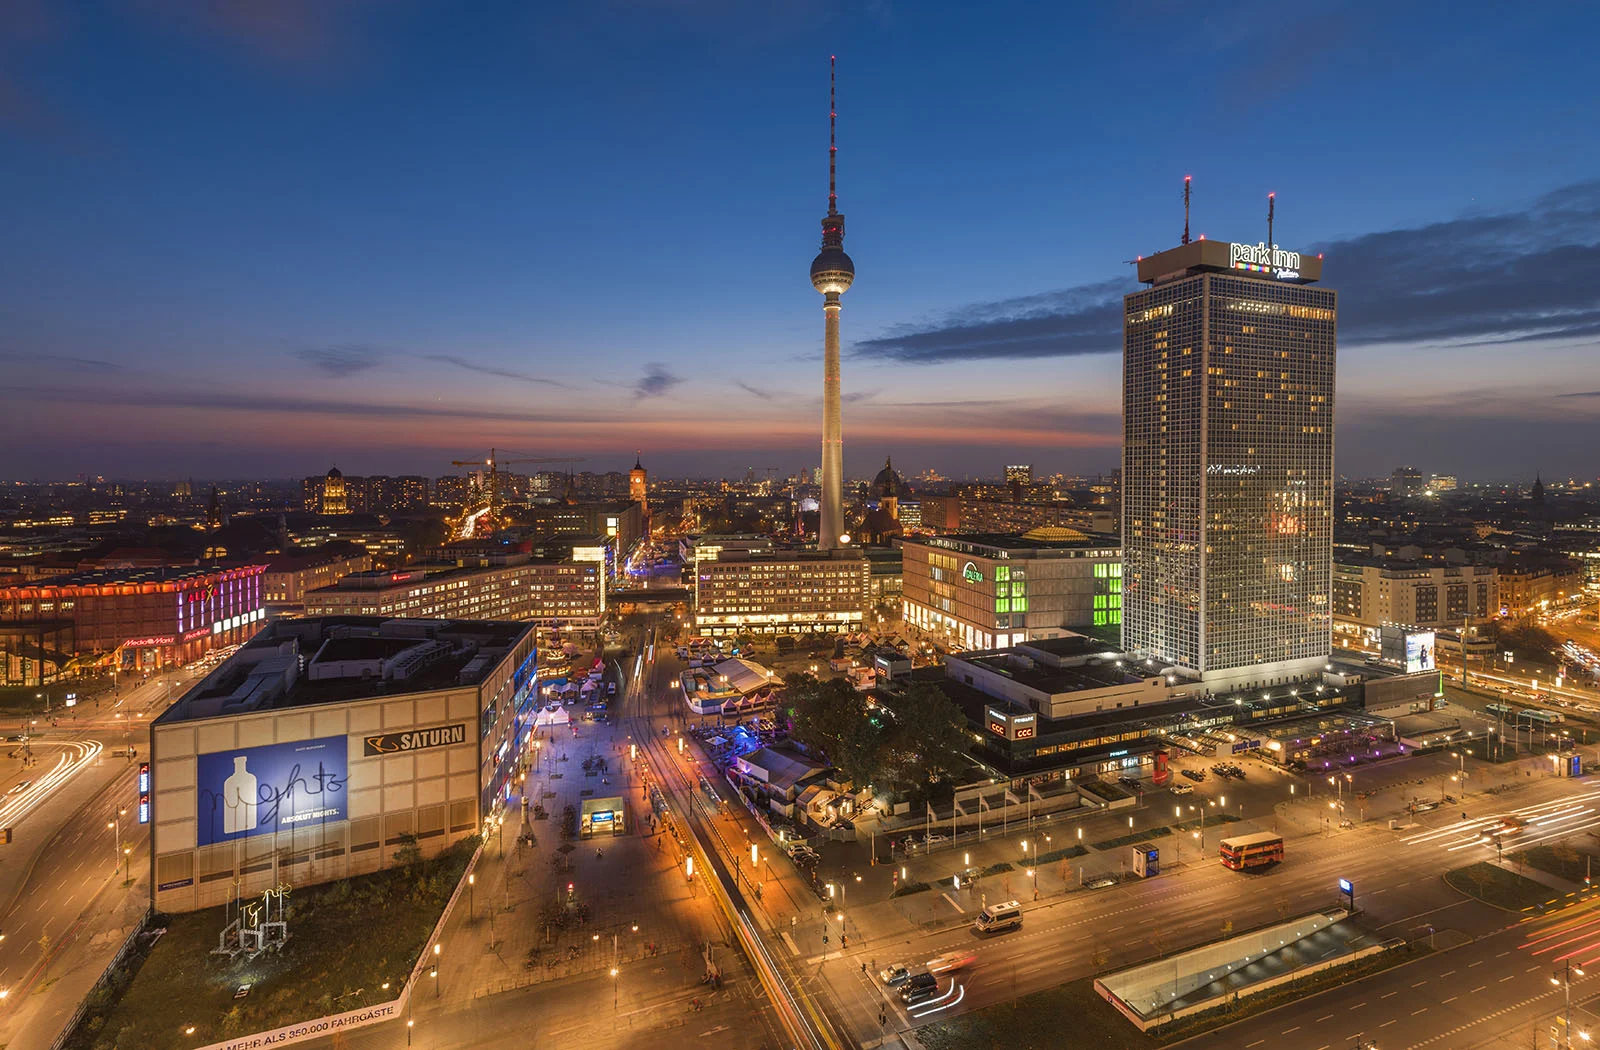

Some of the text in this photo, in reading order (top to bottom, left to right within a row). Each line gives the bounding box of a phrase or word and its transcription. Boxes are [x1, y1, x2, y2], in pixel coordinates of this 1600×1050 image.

[1230, 242, 1300, 270] park inn
[187, 584, 218, 605] ALEXA
[400, 726, 463, 750] SATURN
[991, 723, 1004, 735] CCC
[1017, 728, 1032, 737] CCC
[281, 812, 312, 824] ABSOLUT
[225, 1006, 394, 1050] MEHR ALS 350.000 FAHRGÄSTE
